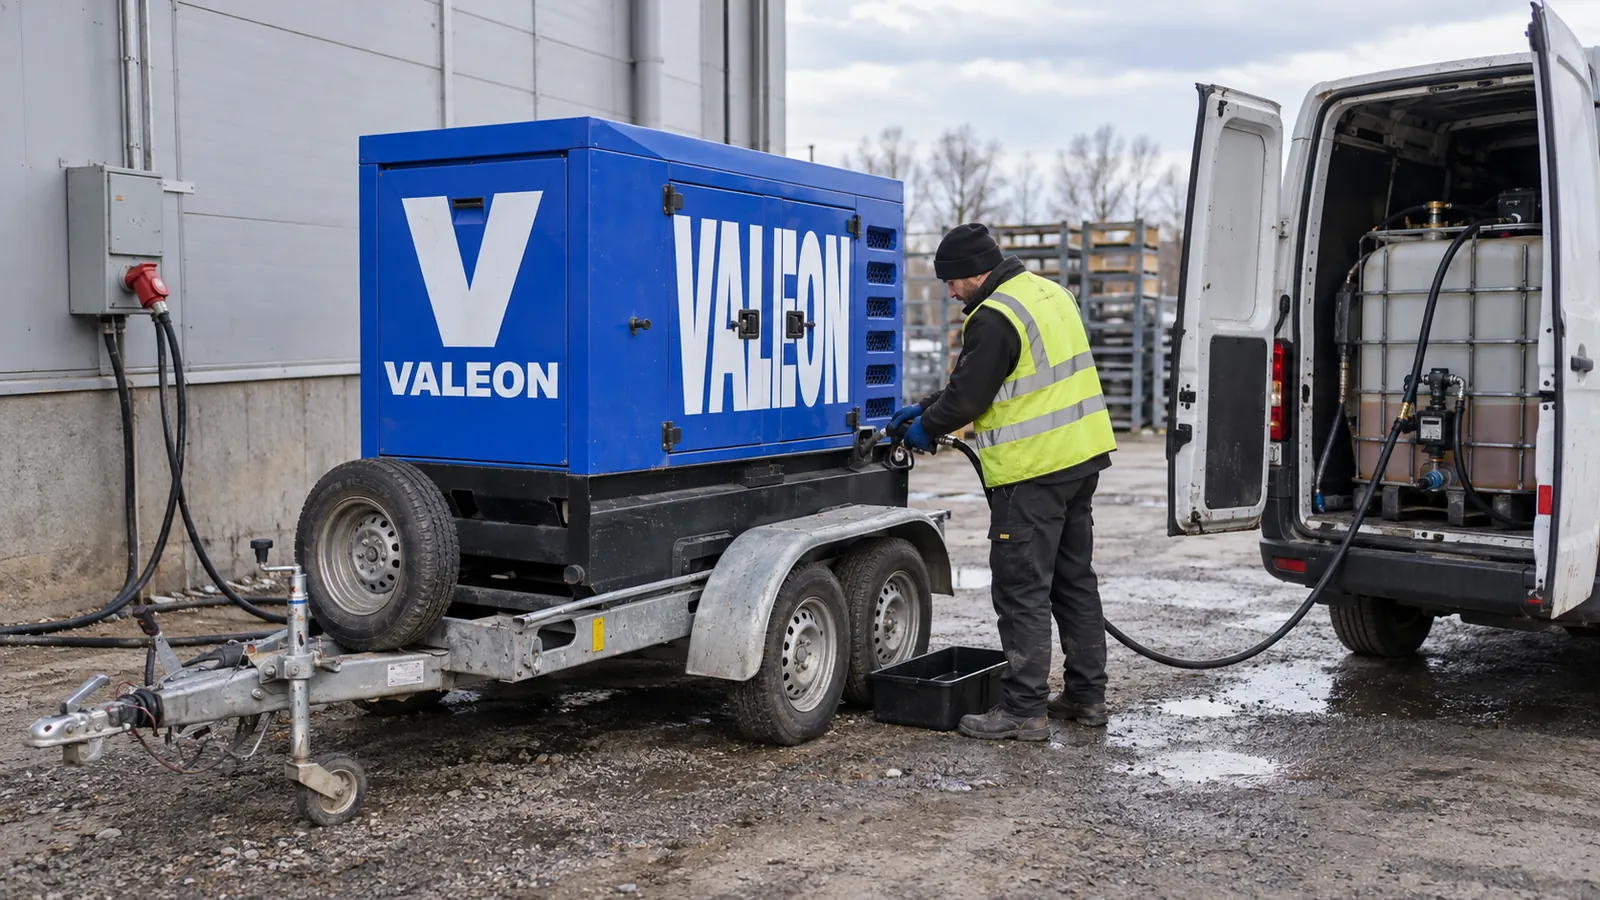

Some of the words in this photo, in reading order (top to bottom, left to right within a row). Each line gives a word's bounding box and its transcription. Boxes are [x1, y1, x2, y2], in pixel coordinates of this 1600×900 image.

[401, 190, 544, 348] V
[673, 214, 850, 416] VALEON
[383, 361, 559, 399] VALEON
